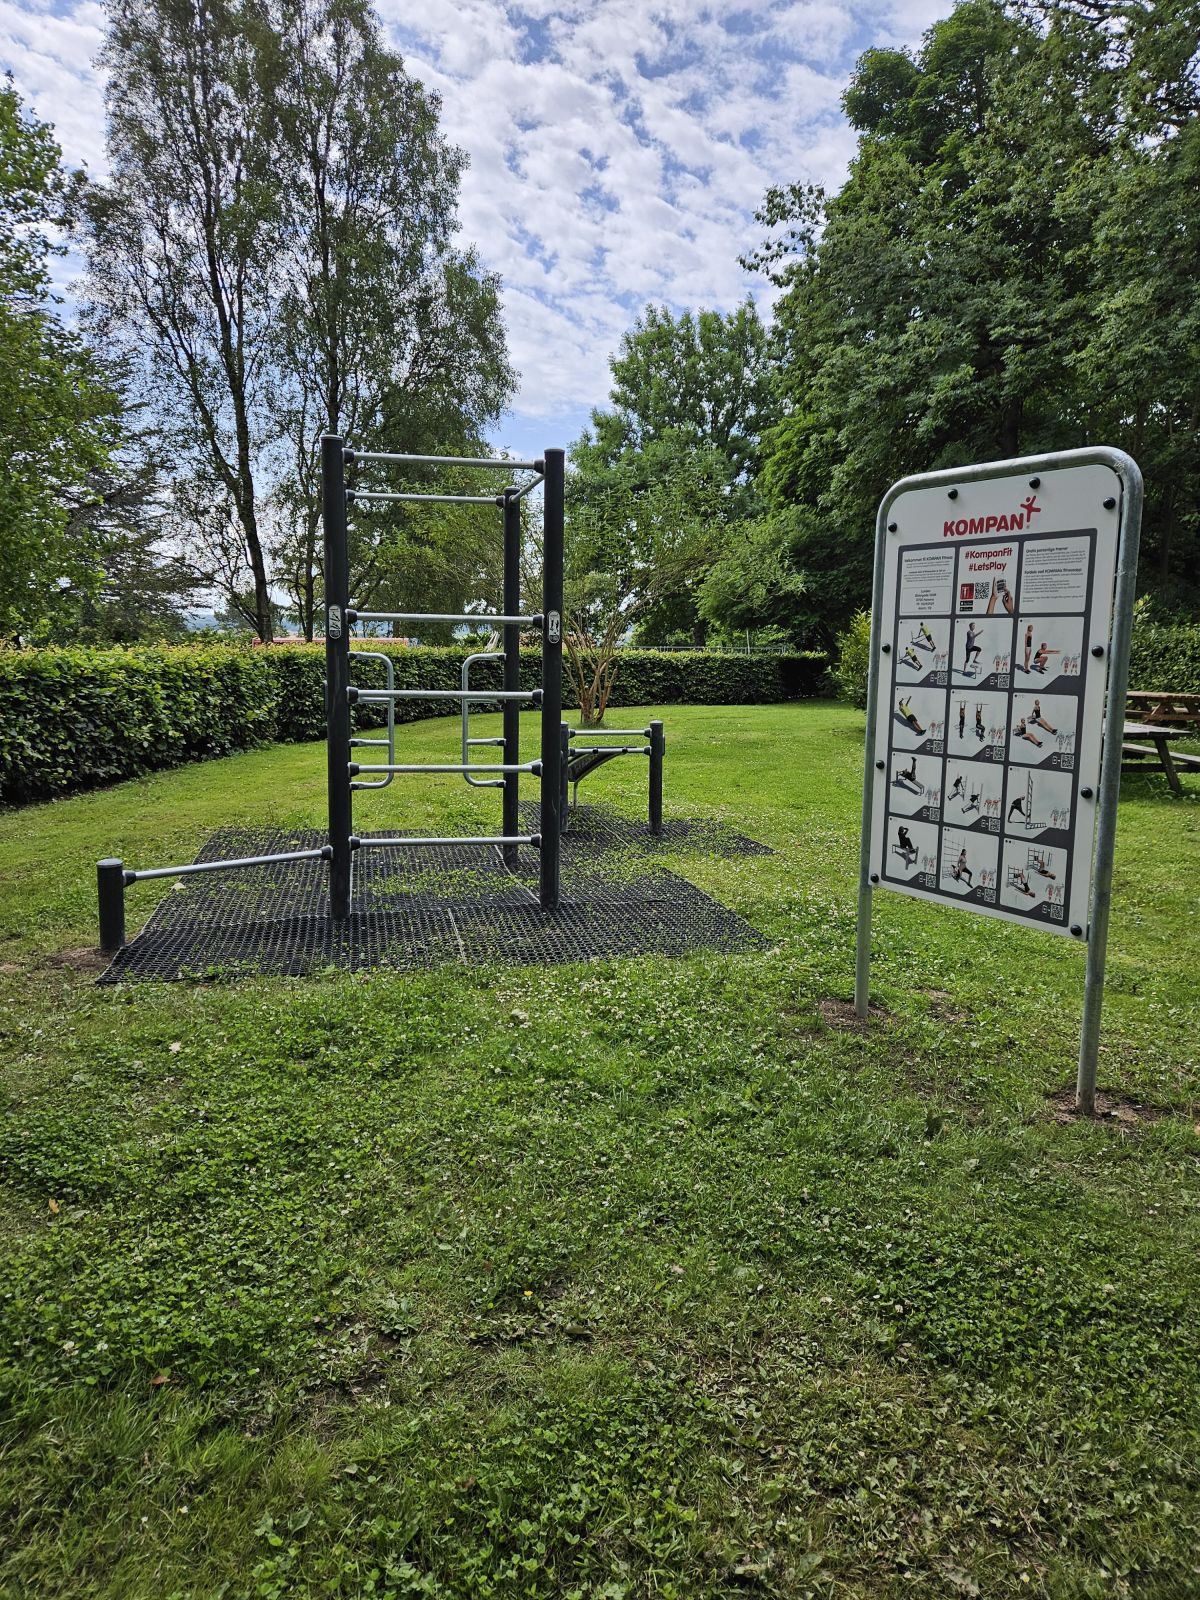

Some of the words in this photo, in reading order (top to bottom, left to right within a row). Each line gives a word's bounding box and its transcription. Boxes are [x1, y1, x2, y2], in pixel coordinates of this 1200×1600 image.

[943, 513, 1024, 537] KOMPAN
[965, 547, 1013, 559] #KompanFit
[969, 561, 1007, 571] #LetsPlay
